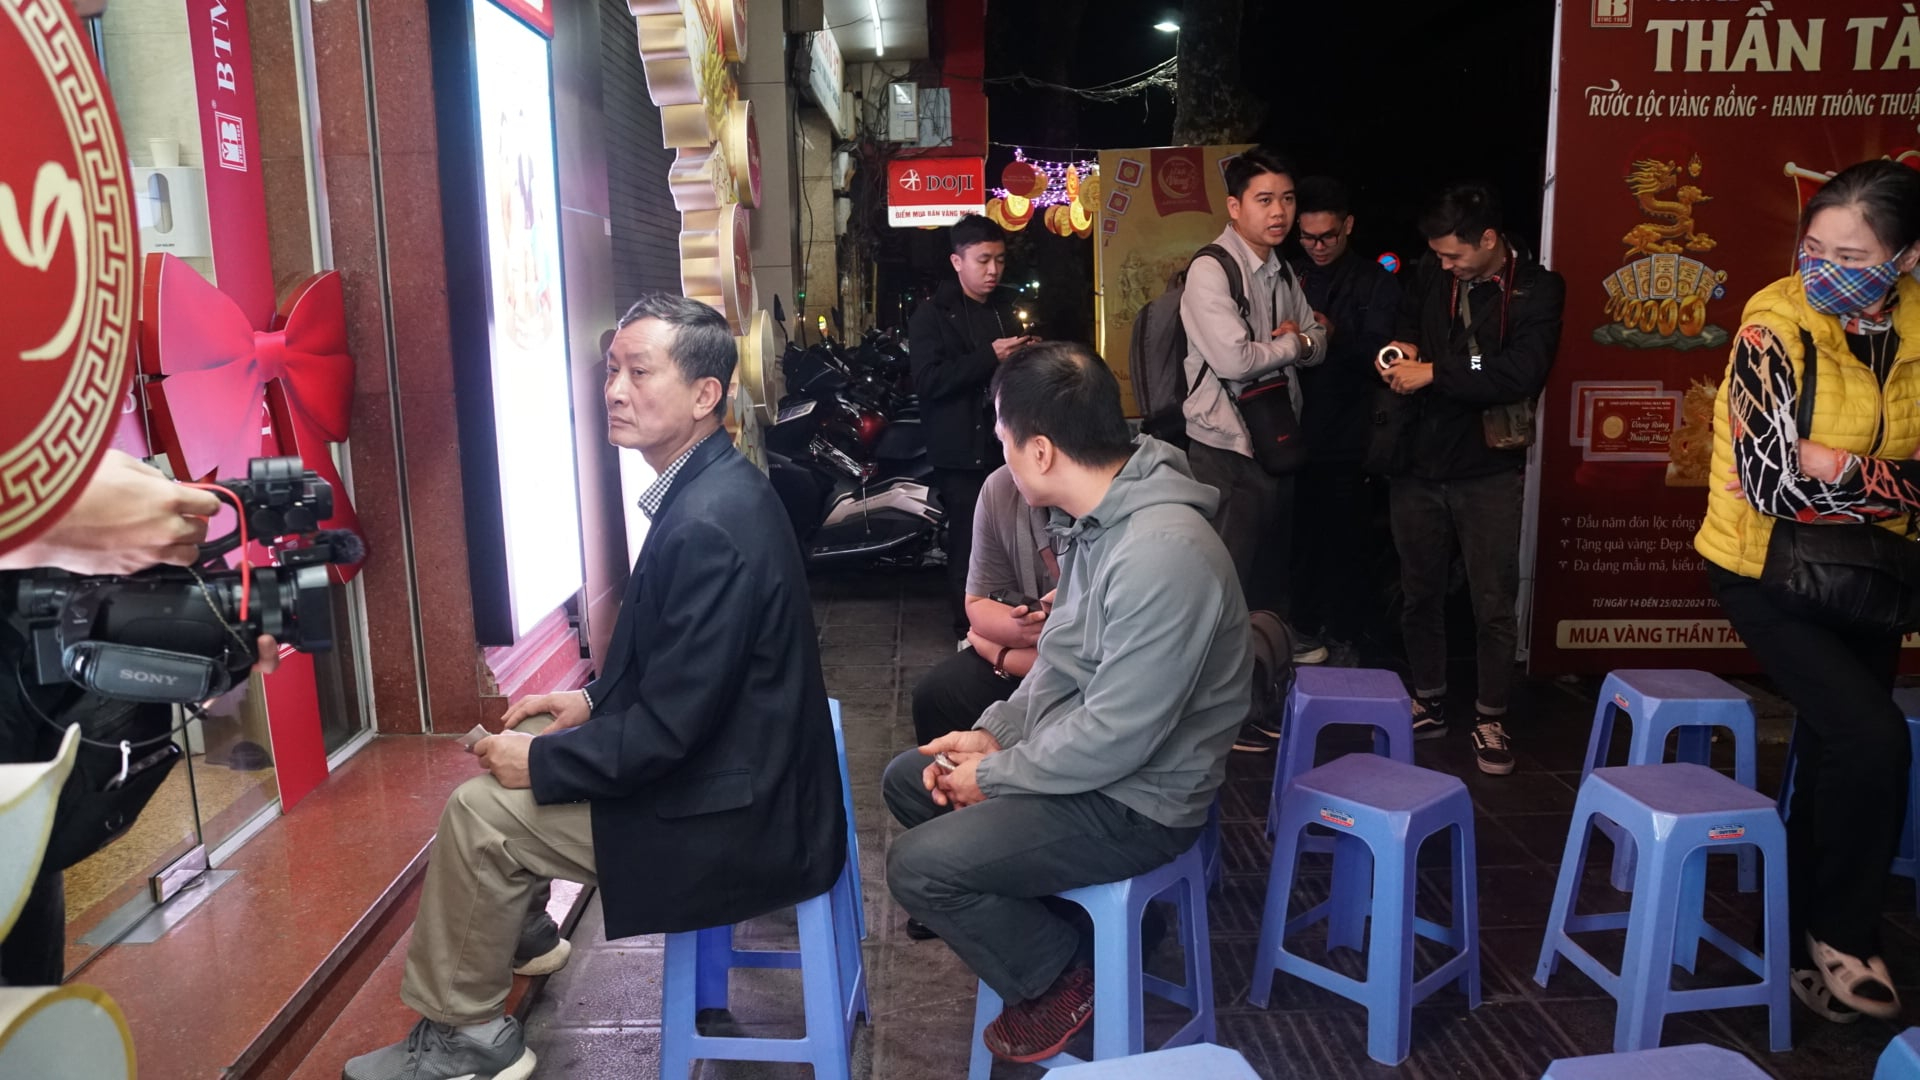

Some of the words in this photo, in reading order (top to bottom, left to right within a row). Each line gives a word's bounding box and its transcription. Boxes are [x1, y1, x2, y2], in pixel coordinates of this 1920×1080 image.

[1645, 1, 1826, 72] THẦN
[1585, 79, 1633, 117] RƯỚC
[1635, 89, 1666, 122] LỘC
[1669, 89, 1711, 117] VÀNG
[1713, 84, 1758, 117] RỒNG
[1771, 95, 1817, 117] HANH
[1821, 89, 1876, 117] THÔNG
[926, 174, 975, 197] DOJI
[1576, 513, 1599, 528] Đầu
[1602, 516, 1626, 528] năm
[1629, 515, 1649, 528] đón
[1653, 515, 1669, 530] lộc
[1672, 513, 1696, 531] rồng
[1576, 537, 1601, 553] Tặng
[1604, 538, 1624, 552] quà
[1660, 538, 1683, 553] Đẹp
[1574, 559, 1590, 571] Đa
[1592, 559, 1619, 574] dạng
[1604, 596, 1628, 608] NGÀY
[1630, 598, 1639, 608] 14
[1659, 598, 1704, 608] 25/02/2024
[1569, 627, 1608, 643] MUA
[1613, 624, 1662, 643] VÀNG
[1666, 622, 1713, 643] THẦN
[120, 668, 179, 685] SONY
